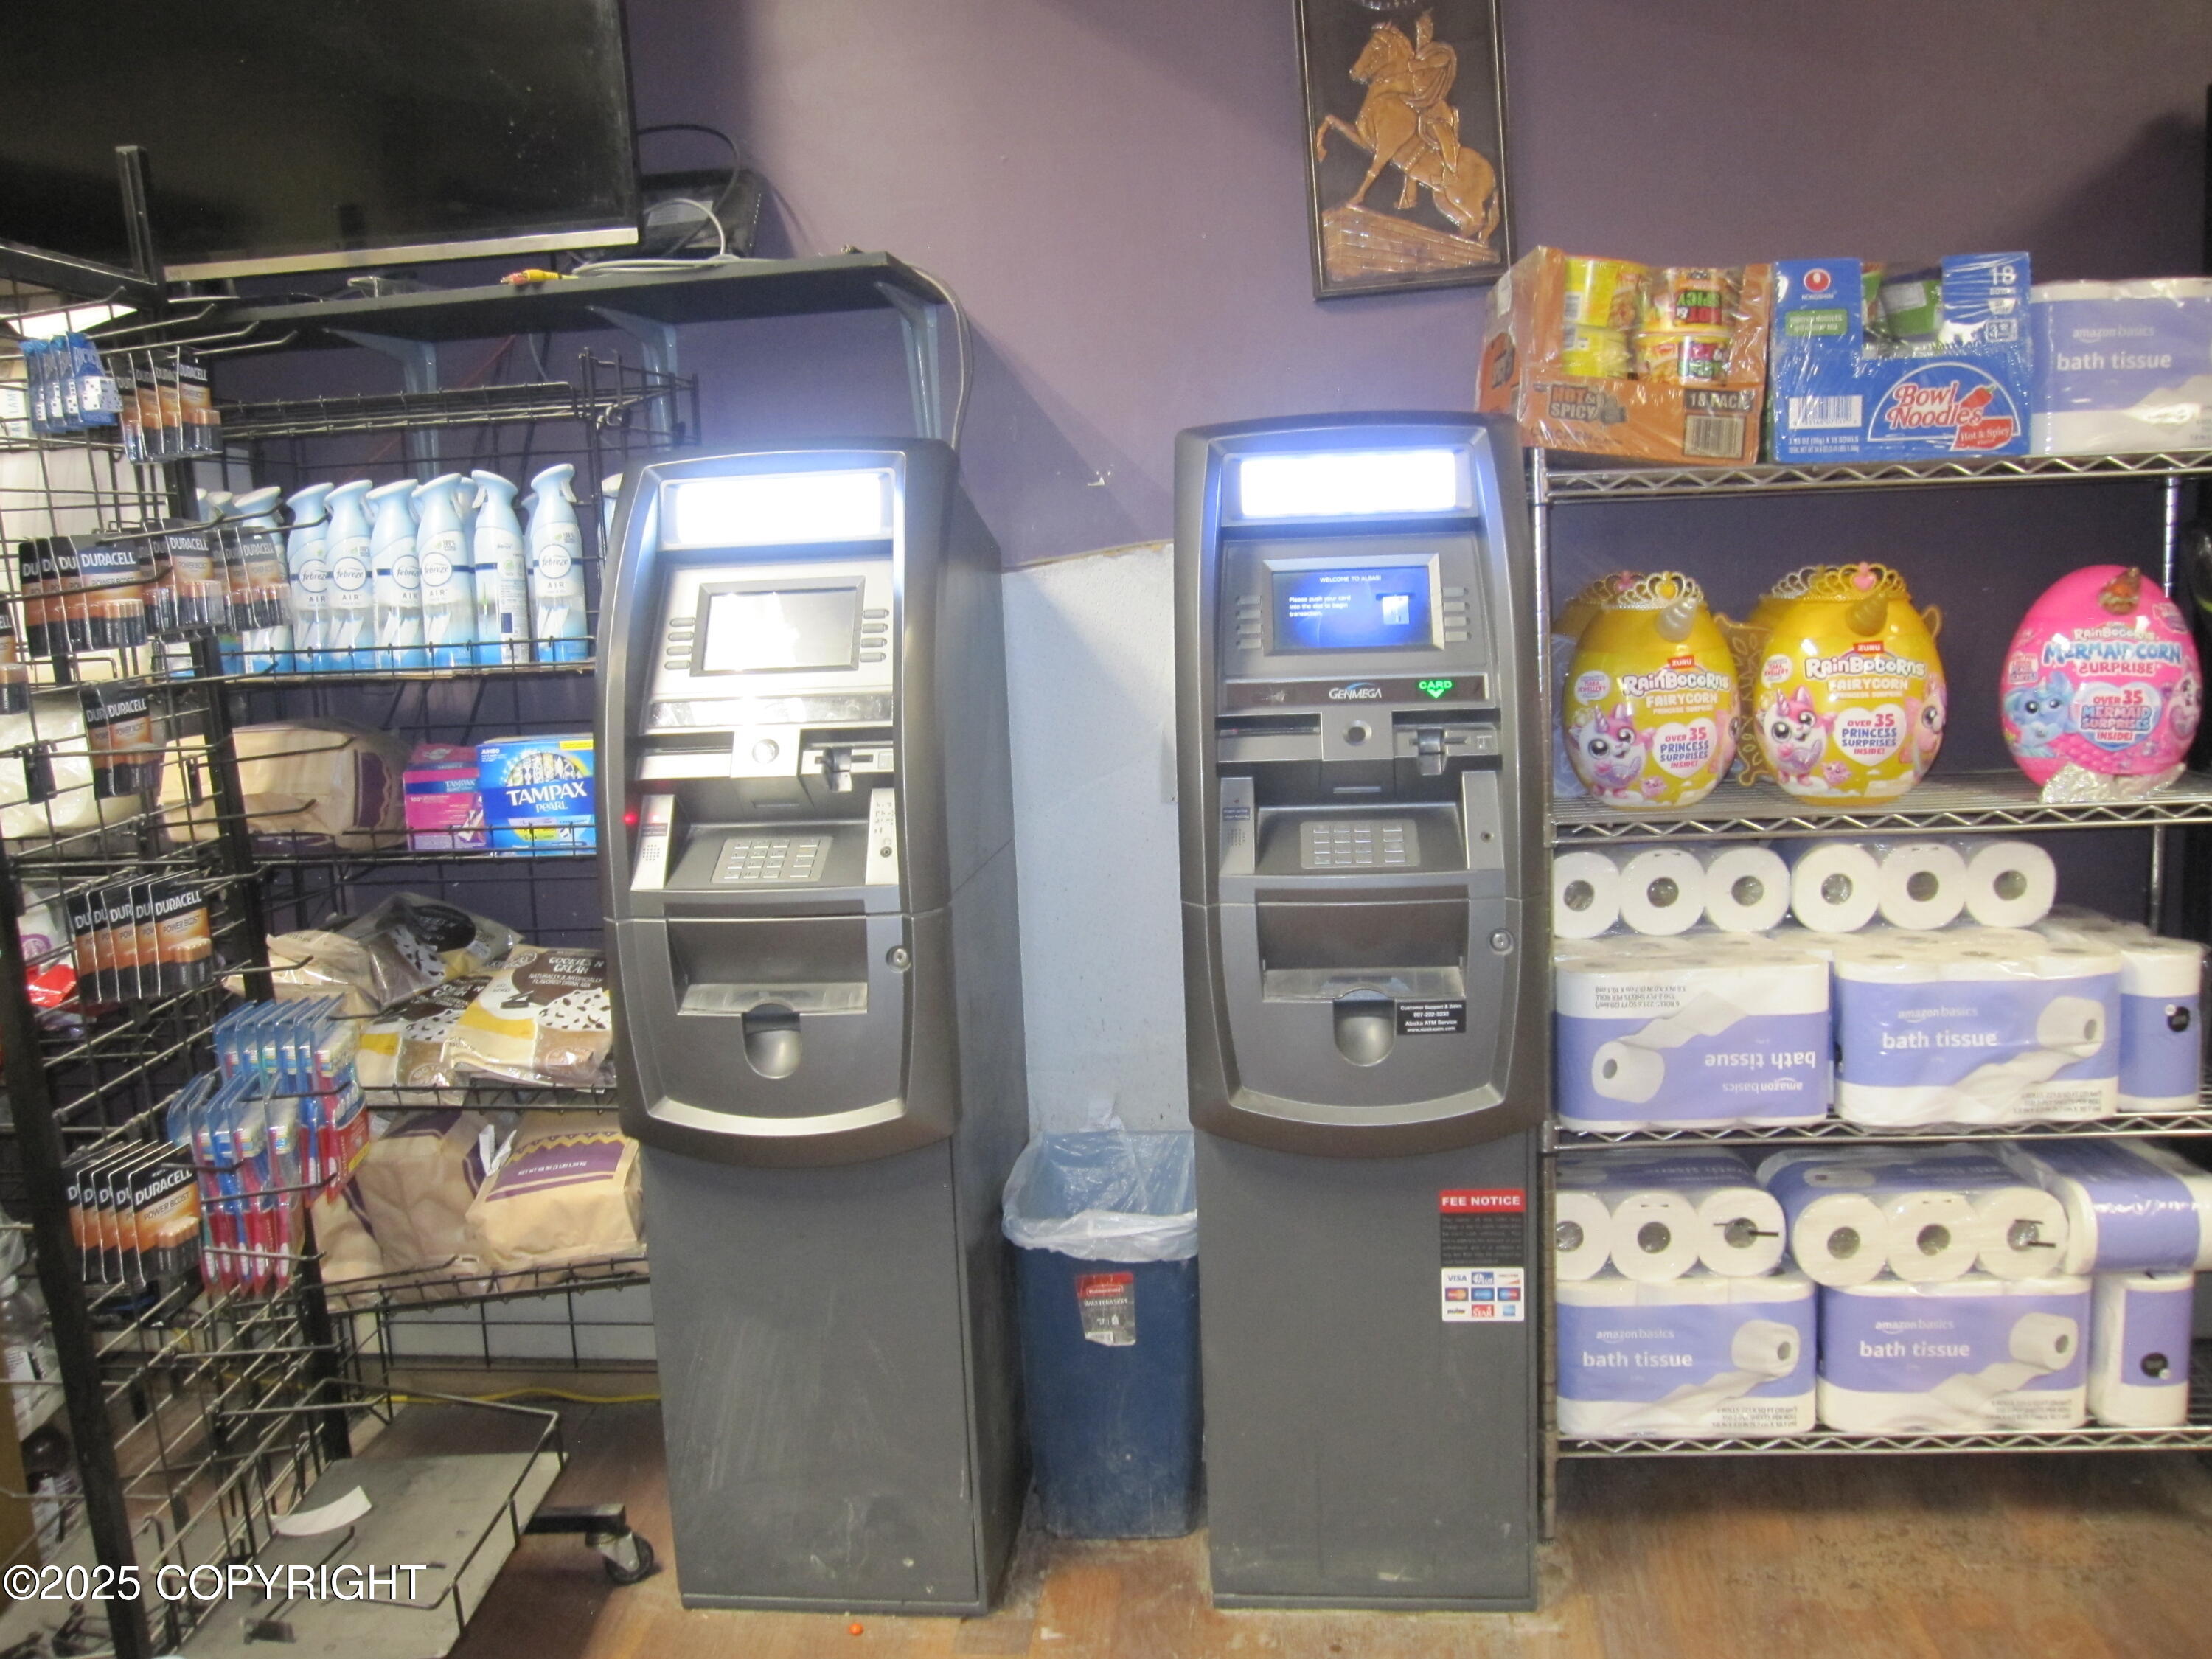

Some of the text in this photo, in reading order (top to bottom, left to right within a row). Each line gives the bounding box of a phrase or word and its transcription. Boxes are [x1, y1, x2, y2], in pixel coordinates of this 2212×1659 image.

[1992, 265, 2017, 285] 18
[2056, 350, 2172, 371] bath tissue
[179, 364, 209, 381] DURACELL
[1551, 383, 1587, 403] HOT
[1585, 392, 1597, 405] &
[1893, 380, 1959, 406] Bowl
[1690, 394, 1705, 407] 18
[1551, 403, 1599, 420] SPICY
[1885, 403, 1984, 430] Noodles
[1961, 431, 1978, 440] Hot
[1986, 428, 2009, 439] Spicy
[170, 537, 209, 551] DURACELL
[243, 543, 275, 557] DURACELL
[81, 552, 136, 567] DURACELL
[543, 555, 568, 566] febreze
[337, 568, 364, 579] febreze
[424, 563, 449, 575] febreze
[1672, 658, 1693, 667] ZURU
[2078, 662, 2154, 675] SURPRISE
[1419, 681, 1453, 691] CARD
[1828, 678, 1909, 691] FAIRYCORN
[1329, 687, 1382, 700] GENMEGA
[1646, 693, 1718, 708] FAIRYCORN
[2093, 689, 2144, 704] OVER 35
[108, 698, 147, 717] DURACELL
[2081, 706, 2152, 718] MERMAID
[1874, 713, 1895, 726] 35
[2081, 717, 2151, 730] SURPRISES
[1665, 727, 1708, 742] OVER 35
[1842, 728, 1897, 737] PRINCESS
[2096, 732, 2133, 740] INSIDE!
[1660, 740, 1709, 753] PRINCESS
[1842, 738, 1896, 747] SURPRISES
[1660, 751, 1708, 762] SURPRISES
[1670, 760, 1698, 769] INSIDE!
[445, 779, 476, 787] TAMPAX
[506, 781, 587, 807] TAMPAX
[155, 890, 202, 917] DURACELL
[164, 915, 201, 933] POWER BOOST
[553, 963, 589, 974] CREAM
[1882, 1030, 1998, 1050] bath tissue
[1704, 1051, 1816, 1070] bath tissue
[135, 1169, 193, 1206] DURACELL
[144, 1192, 190, 1221] POWER BOOST
[1442, 1196, 1520, 1206] FEE NOTICE
[1860, 1340, 1971, 1357] bath tissue
[1583, 1351, 1694, 1368] bath tissue
